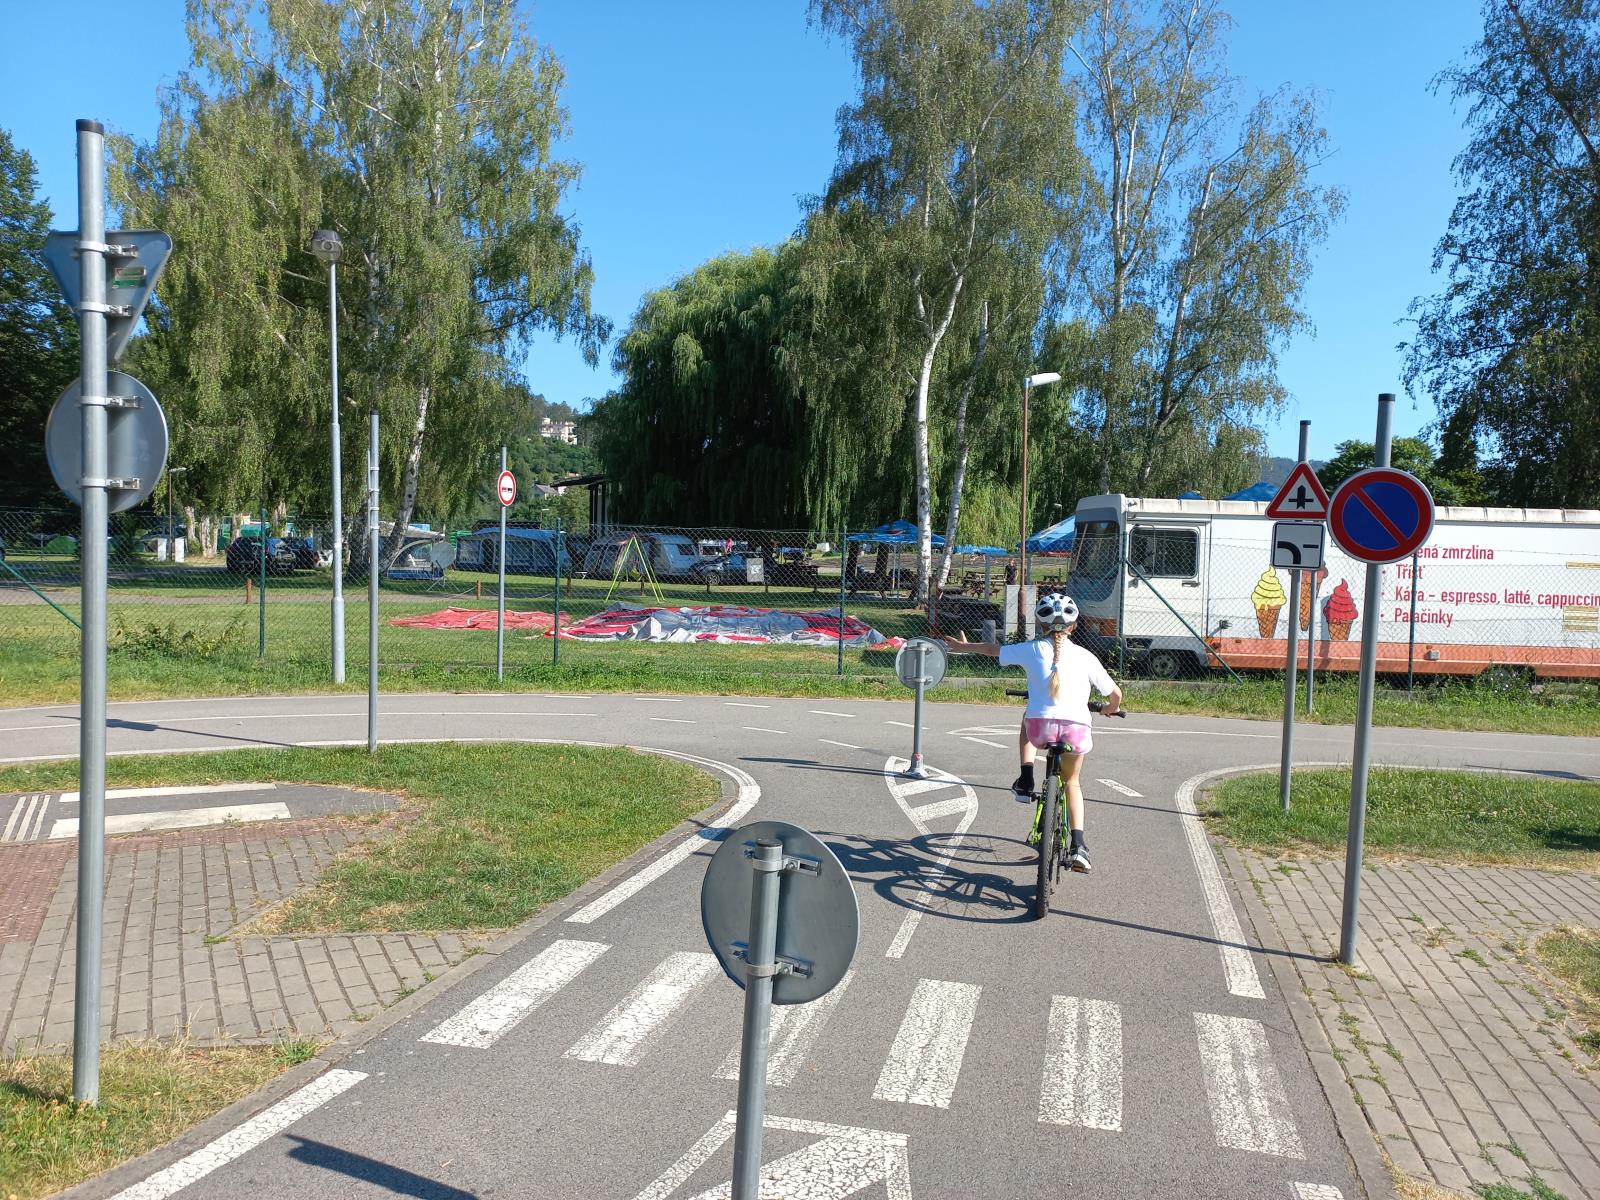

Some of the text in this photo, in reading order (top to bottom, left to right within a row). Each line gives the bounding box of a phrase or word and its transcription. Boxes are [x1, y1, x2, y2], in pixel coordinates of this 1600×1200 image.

[1442, 544, 1494, 560] zmrzlina
[1396, 564, 1426, 580] Tříť
[1395, 586, 1425, 602] Káa
[1441, 591, 1501, 607] espresso,
[1504, 588, 1533, 606] latté,
[1537, 593, 1600, 610] cappuccin
